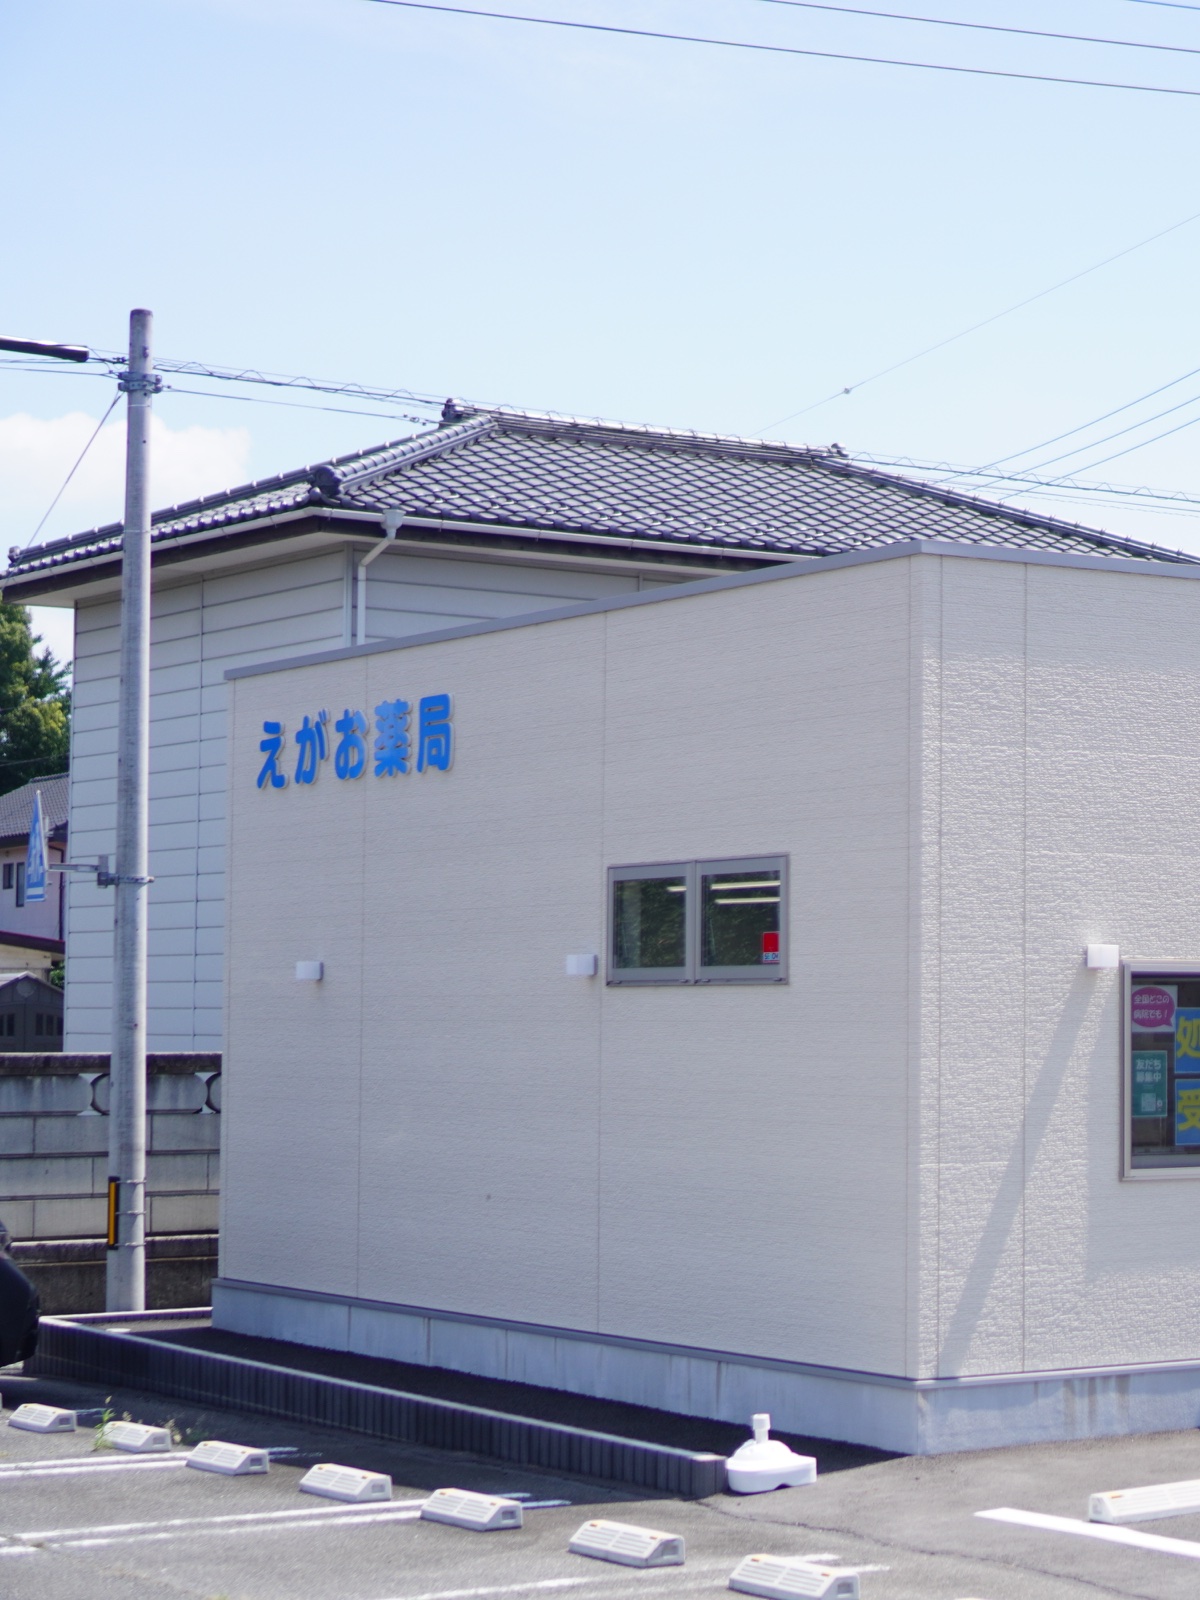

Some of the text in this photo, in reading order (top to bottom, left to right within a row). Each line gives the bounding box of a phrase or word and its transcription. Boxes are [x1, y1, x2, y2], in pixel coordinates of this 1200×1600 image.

[256, 693, 454, 789] えがお薬局
[1136, 1058, 1161, 1070] 友だち
